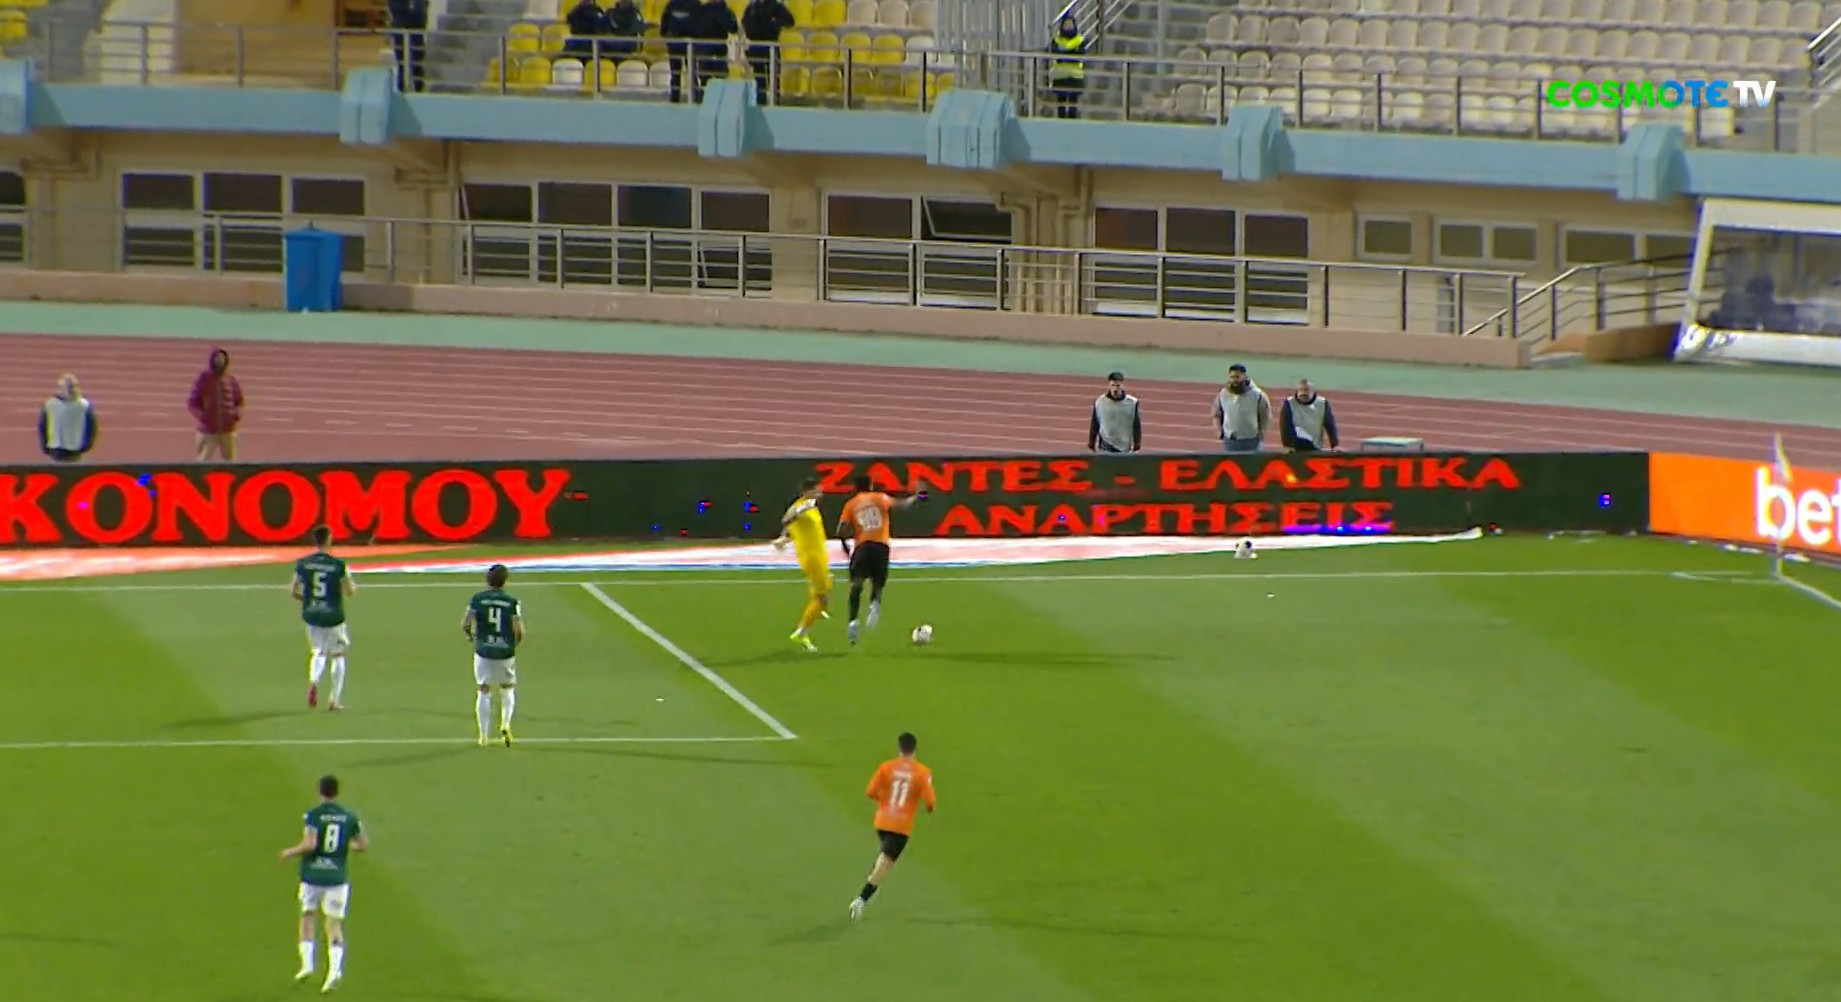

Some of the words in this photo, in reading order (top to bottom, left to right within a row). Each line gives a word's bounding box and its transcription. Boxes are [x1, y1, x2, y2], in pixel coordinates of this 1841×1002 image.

[814, 460, 1092, 493] ΖΑΝΤΕΣ
[1159, 457, 1521, 491] ΕΛΑΣΤΙΚΑ
[934, 502, 1396, 534] ΑΝΑΡΤΗΣΕΙΣ
[312, 571, 328, 598] 5
[488, 607, 502, 633] 4
[889, 780, 910, 809] 11
[324, 822, 341, 854] 8
